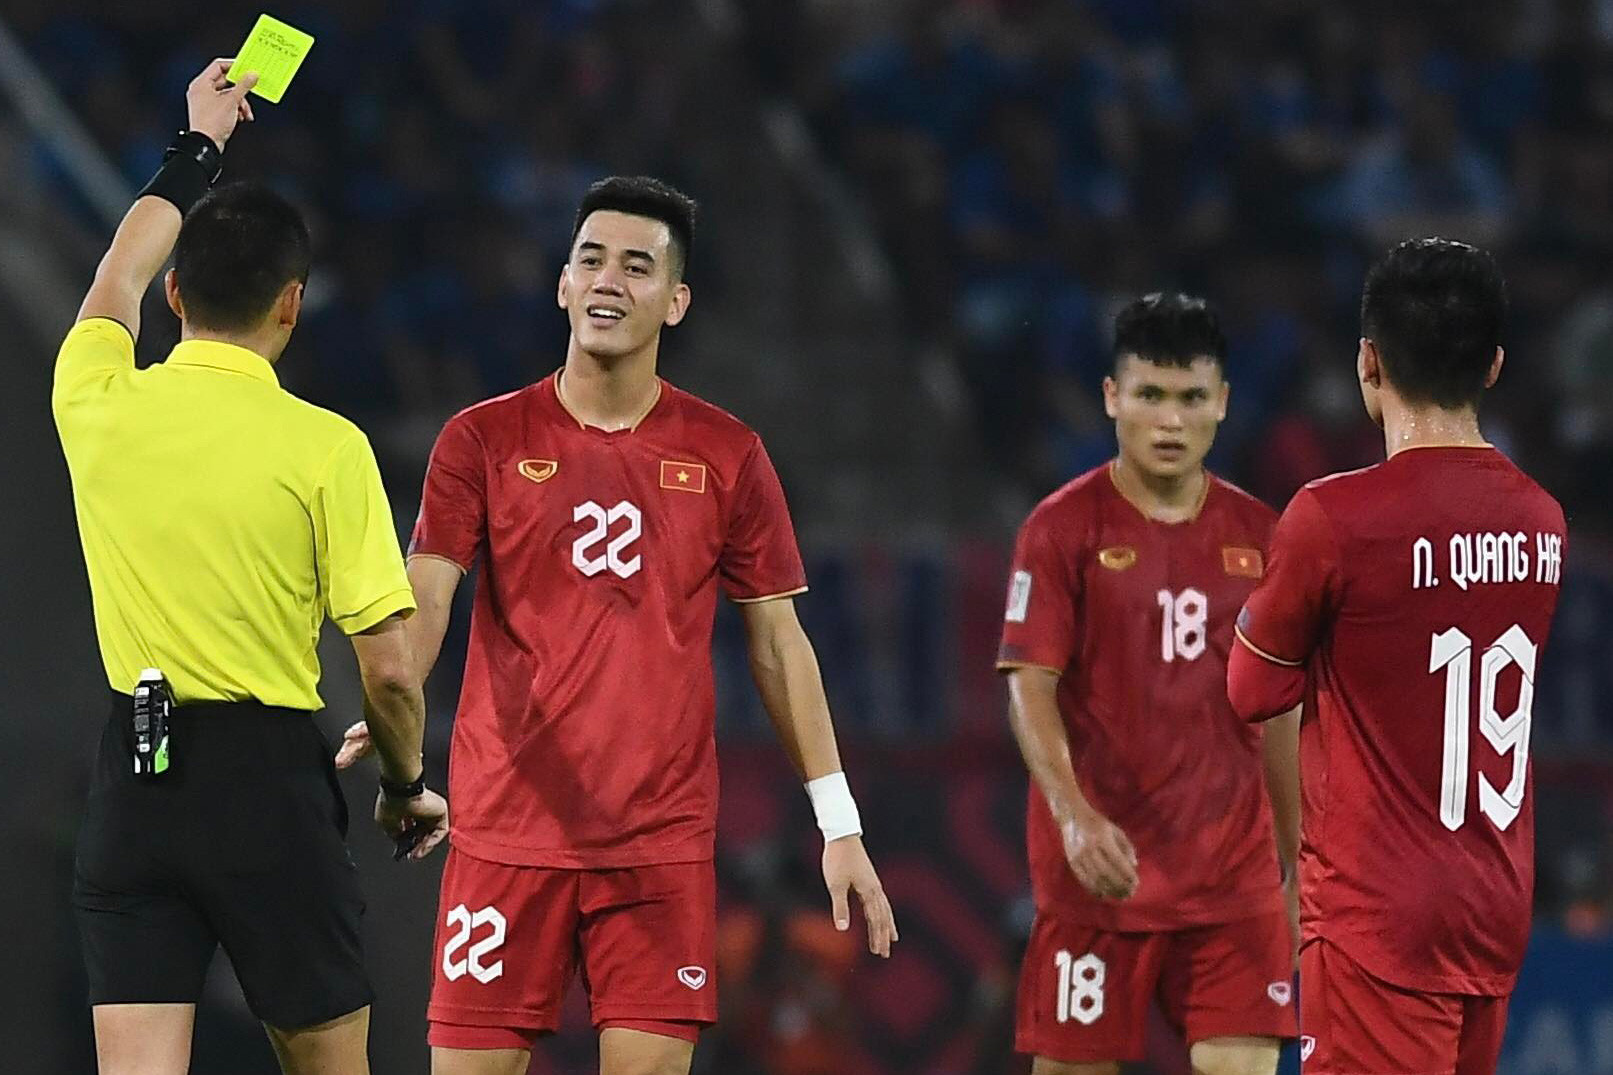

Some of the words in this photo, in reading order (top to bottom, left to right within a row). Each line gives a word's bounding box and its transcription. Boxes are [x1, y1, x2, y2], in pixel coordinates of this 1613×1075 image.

[571, 500, 642, 579] 22
[1413, 537, 1439, 589] N.
[1449, 531, 1529, 591] QUANG
[1157, 588, 1208, 663] 18
[1428, 624, 1538, 832] 19
[442, 904, 507, 984] 22
[1055, 950, 1105, 1025] 18
